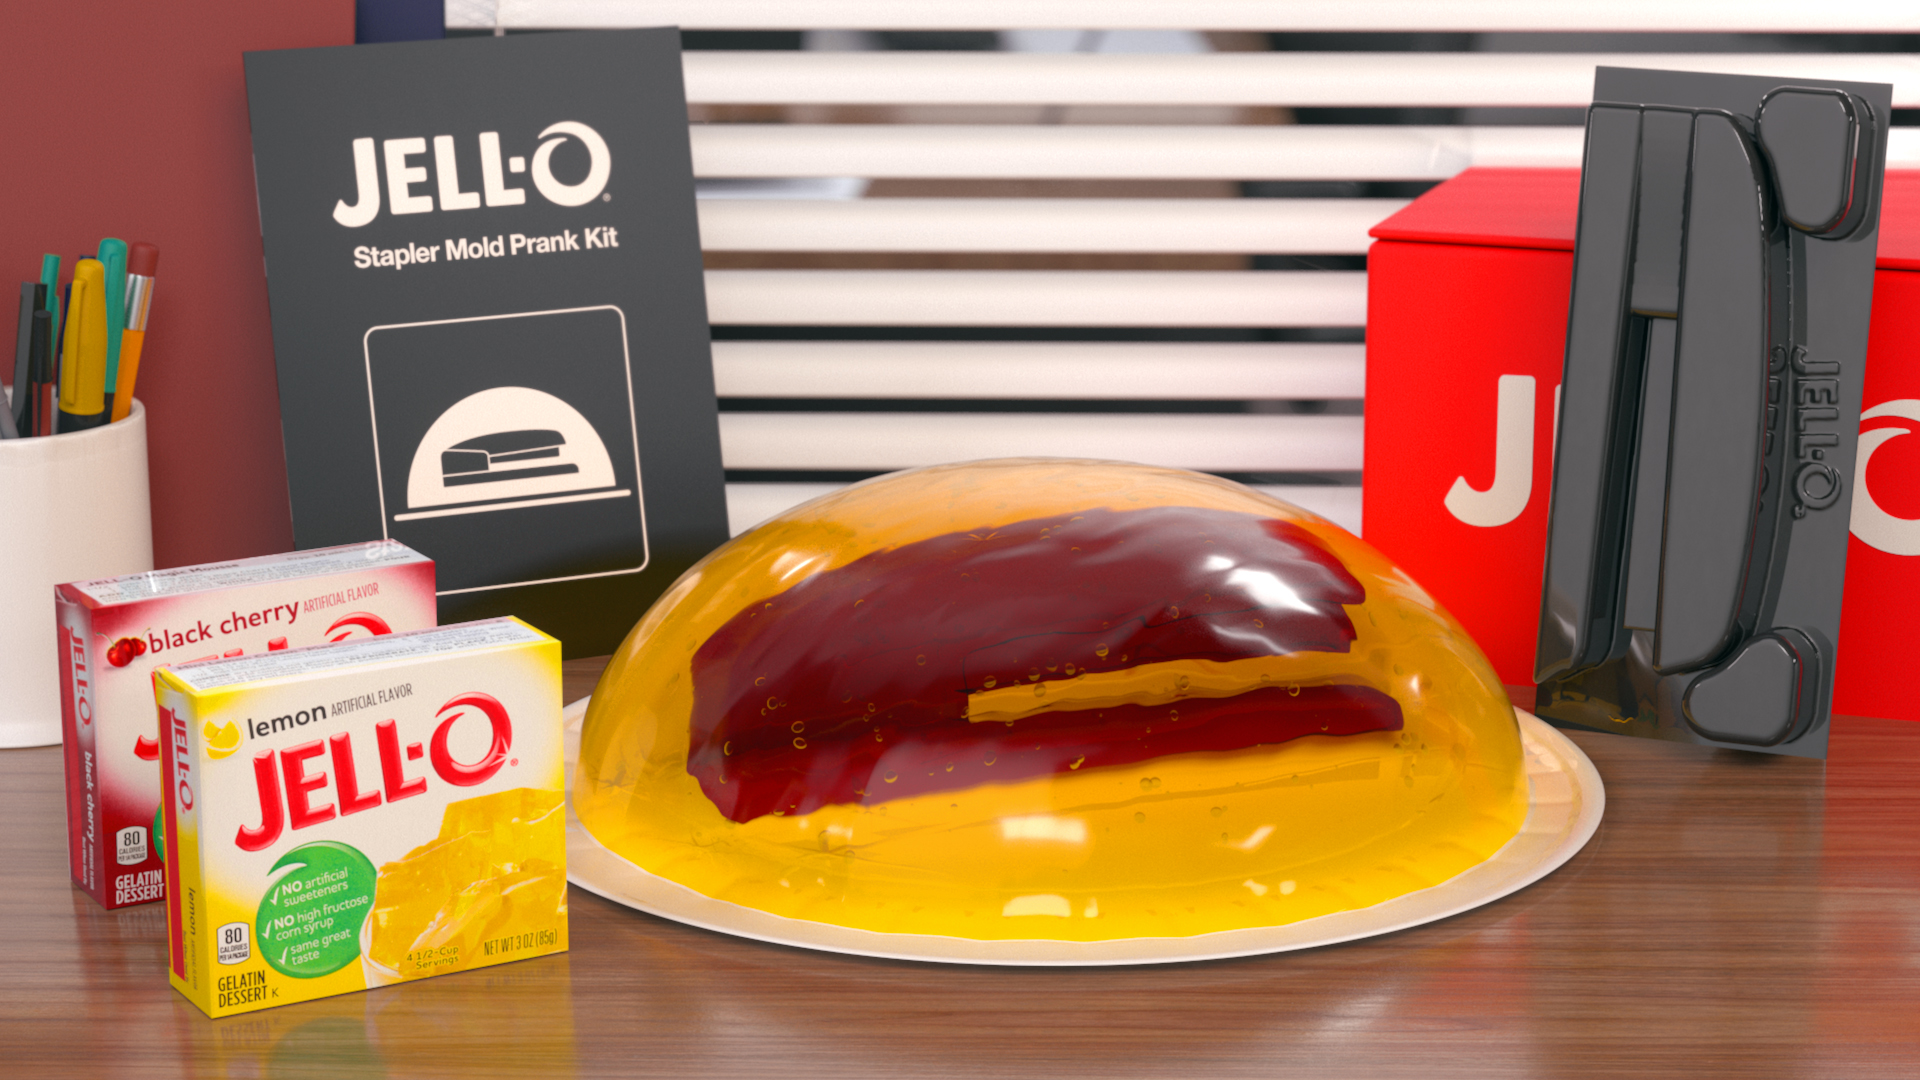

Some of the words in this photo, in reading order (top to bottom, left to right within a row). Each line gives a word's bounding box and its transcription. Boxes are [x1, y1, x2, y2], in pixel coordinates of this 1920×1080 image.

[353, 241, 440, 270] Stapler
[445, 236, 505, 261] Mold
[510, 230, 580, 258] Prank
[584, 227, 619, 249] Kit
[148, 621, 212, 654] black
[220, 601, 299, 635] cherry
[303, 590, 346, 614] ARTIFICIAL
[347, 582, 380, 601] FLAVOR
[247, 702, 327, 739] lemon
[331, 692, 378, 718] ARTIFICIAL
[379, 683, 413, 707] FLAVOR
[84, 751, 94, 791] black
[86, 793, 96, 843] cherry
[118, 845, 146, 854] CALORIES
[124, 831, 140, 847] 80
[115, 869, 162, 890] GELATIN
[282, 880, 303, 896] NO
[305, 866, 349, 890] artificial
[116, 883, 165, 905] DESSERT
[284, 881, 349, 907] sweeteners
[188, 887, 196, 935] lemon
[274, 915, 295, 930] NO
[297, 909, 321, 924] high
[323, 895, 369, 916] fructose
[225, 927, 242, 945] 80
[276, 927, 302, 941] corn
[304, 917, 334, 935] syrup
[220, 943, 248, 954] CALORIES
[291, 939, 320, 955] same
[322, 928, 352, 949] great
[484, 939, 499, 956] NET
[501, 936, 514, 953] WT
[516, 935, 521, 950] 3
[523, 932, 534, 949] OZ
[535, 928, 558, 948] (85g)
[291, 950, 320, 966] taste
[406, 953, 413, 962] 4
[416, 946, 459, 961] 1/2-Cup
[416, 954, 459, 970] Servings
[218, 970, 265, 992] GELATIN
[219, 985, 268, 1008] DESSERT
[271, 987, 279, 998] K
